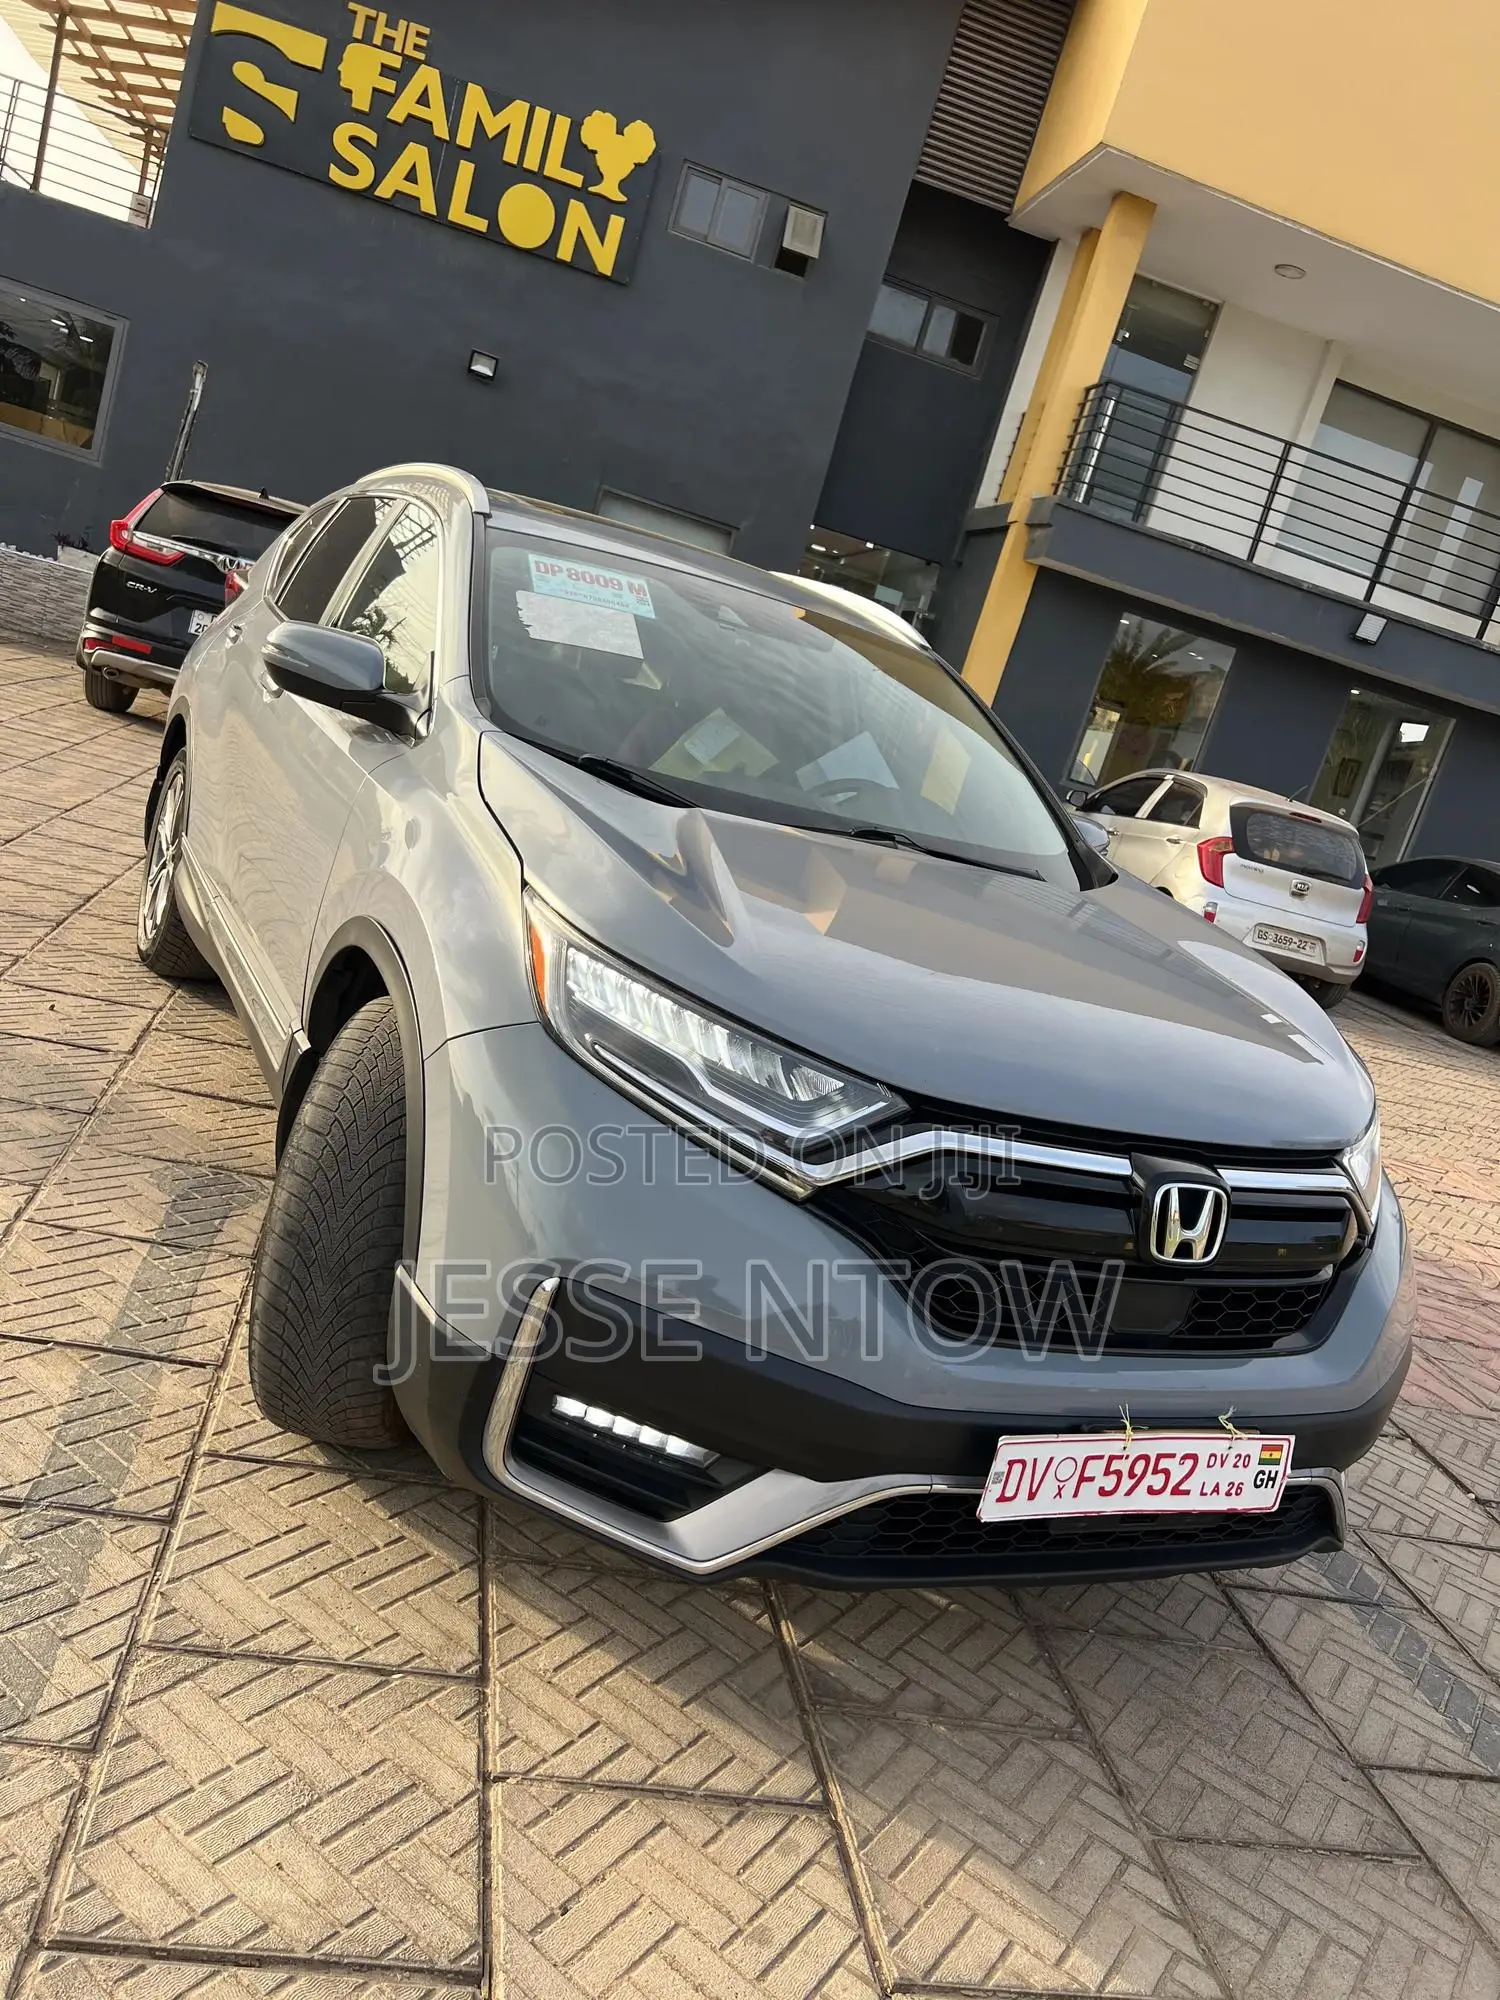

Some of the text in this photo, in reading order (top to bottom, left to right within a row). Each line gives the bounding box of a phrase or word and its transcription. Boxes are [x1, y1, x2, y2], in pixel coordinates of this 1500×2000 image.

[347, 2, 431, 61] THE
[337, 42, 656, 202] FAMILY
[328, 121, 626, 277] SALON
[126, 581, 158, 593] CR-V
[534, 560, 563, 577] DP
[566, 567, 624, 592] 8009
[1257, 929, 1269, 941] GS
[1272, 933, 1308, 950] 3659-22
[1206, 1452, 1252, 1469] DV 20
[995, 1456, 1055, 1503] DV
[1072, 1453, 1200, 1499] F5952
[1199, 1481, 1245, 1497] LA 26
[1253, 1469, 1279, 1489] GH
